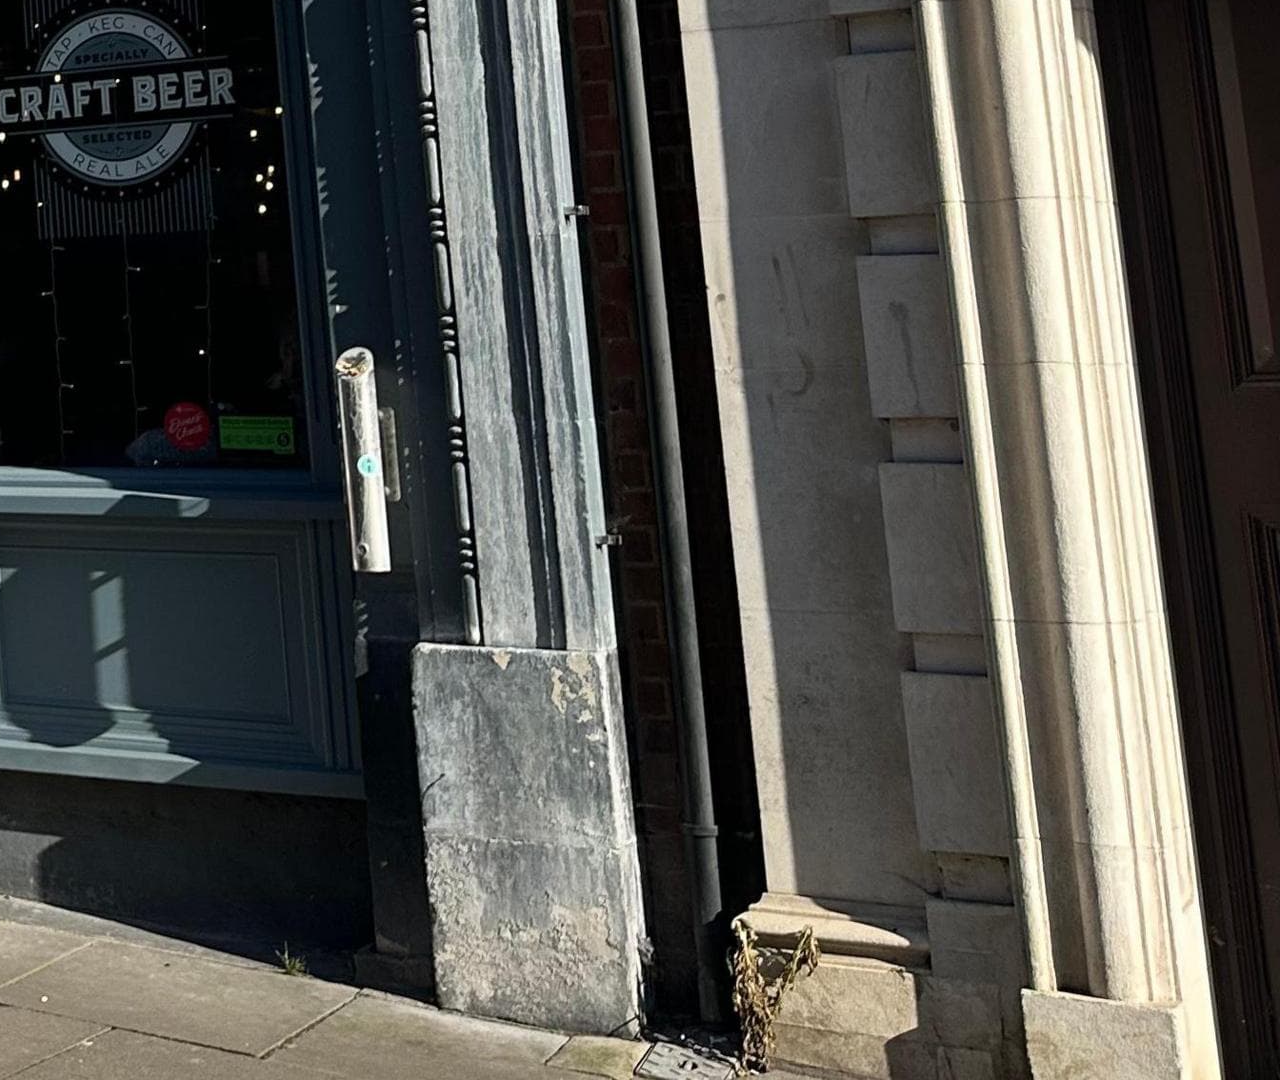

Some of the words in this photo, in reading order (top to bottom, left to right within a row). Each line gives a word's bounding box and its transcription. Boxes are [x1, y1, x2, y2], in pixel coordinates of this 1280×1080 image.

[47, 36, 72, 69] TAP
[143, 24, 178, 56] CAN
[74, 48, 150, 65] SPECIALLY
[131, 68, 236, 113] BEER
[82, 130, 152, 145] SELECTED
[73, 154, 124, 177] REAL
[135, 144, 169, 174] ALE
